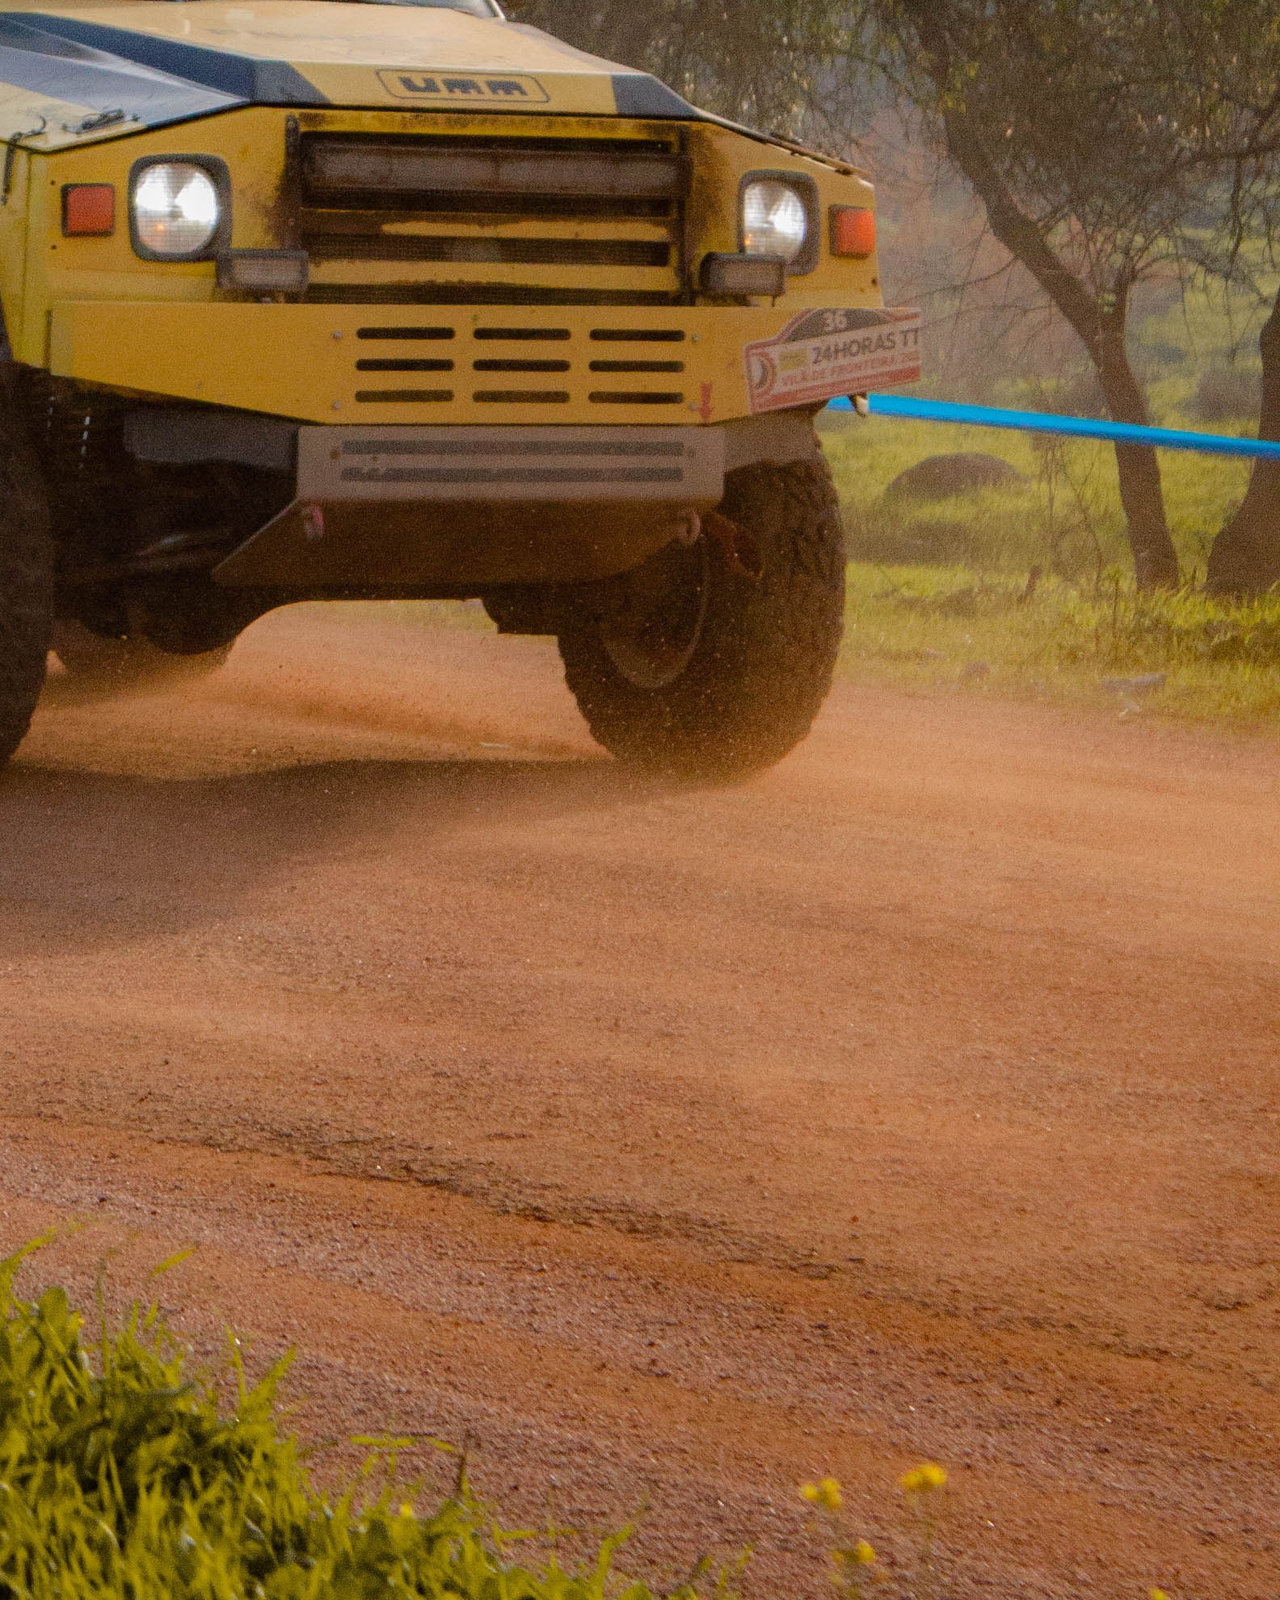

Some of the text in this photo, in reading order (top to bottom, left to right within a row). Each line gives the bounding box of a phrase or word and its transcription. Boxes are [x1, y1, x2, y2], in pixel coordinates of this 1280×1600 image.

[822, 310, 848, 331] 36
[812, 330, 896, 364] 24HORAS
[901, 328, 919, 346] TT
